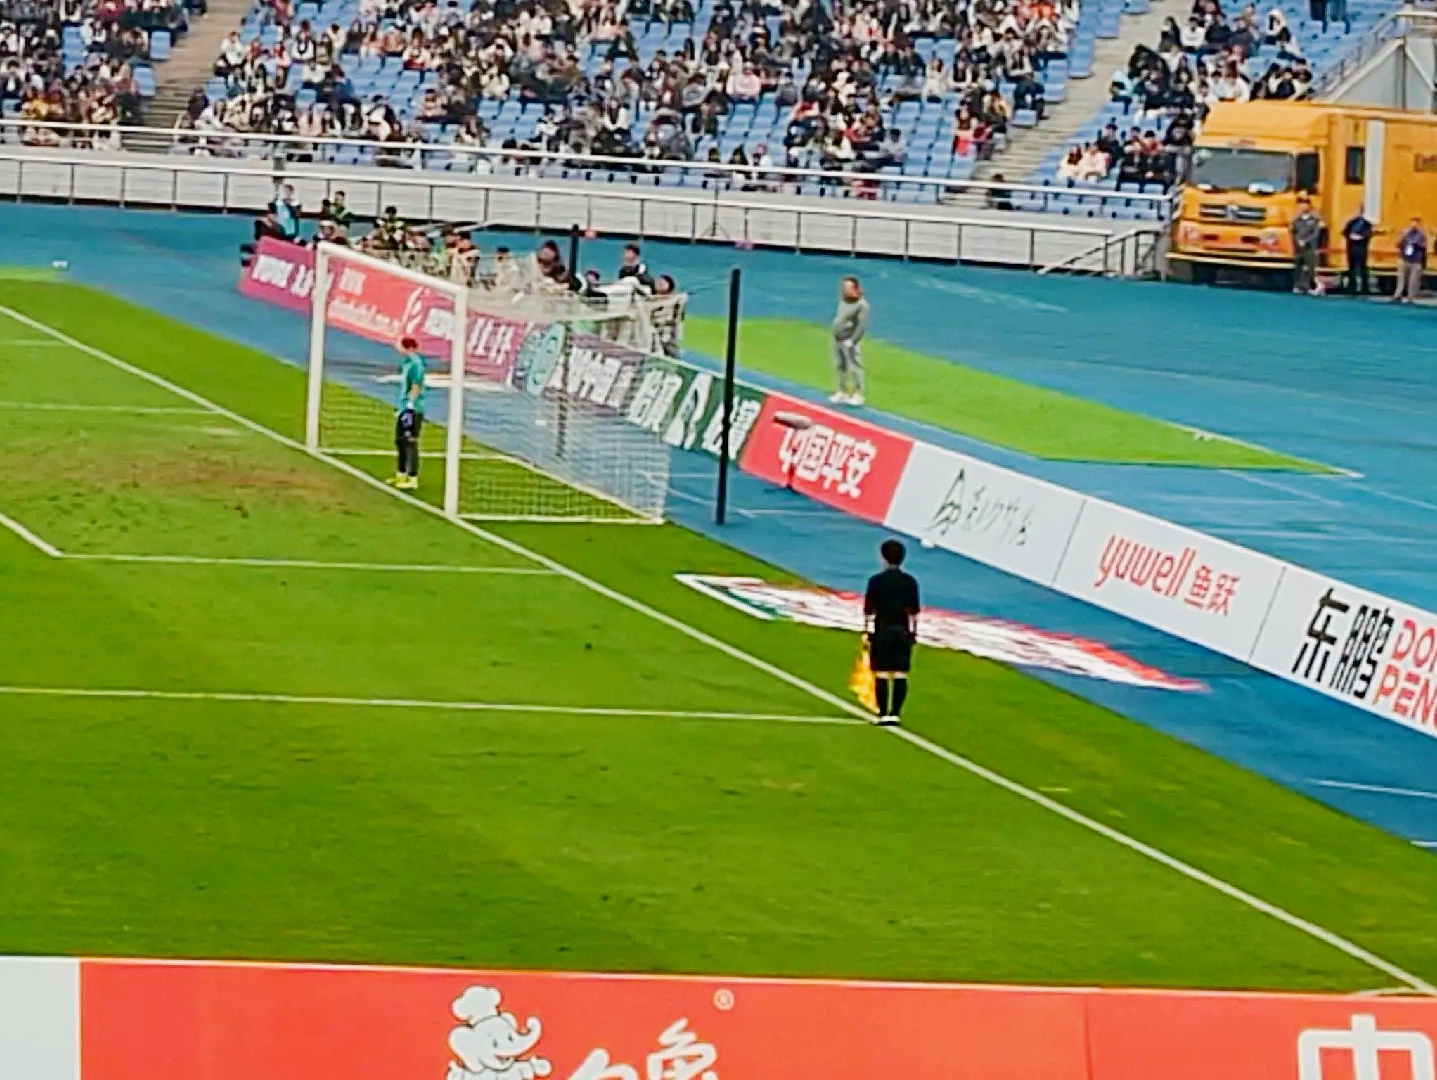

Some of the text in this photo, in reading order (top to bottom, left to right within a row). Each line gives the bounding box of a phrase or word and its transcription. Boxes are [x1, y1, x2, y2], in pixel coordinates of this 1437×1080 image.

[778, 423, 878, 499] 中国平安
[1093, 533, 1242, 617] yuwell 鱼跃
[1290, 587, 1396, 700] 东鹏
[1392, 617, 1437, 672] DO
[1372, 663, 1437, 727] PEN
